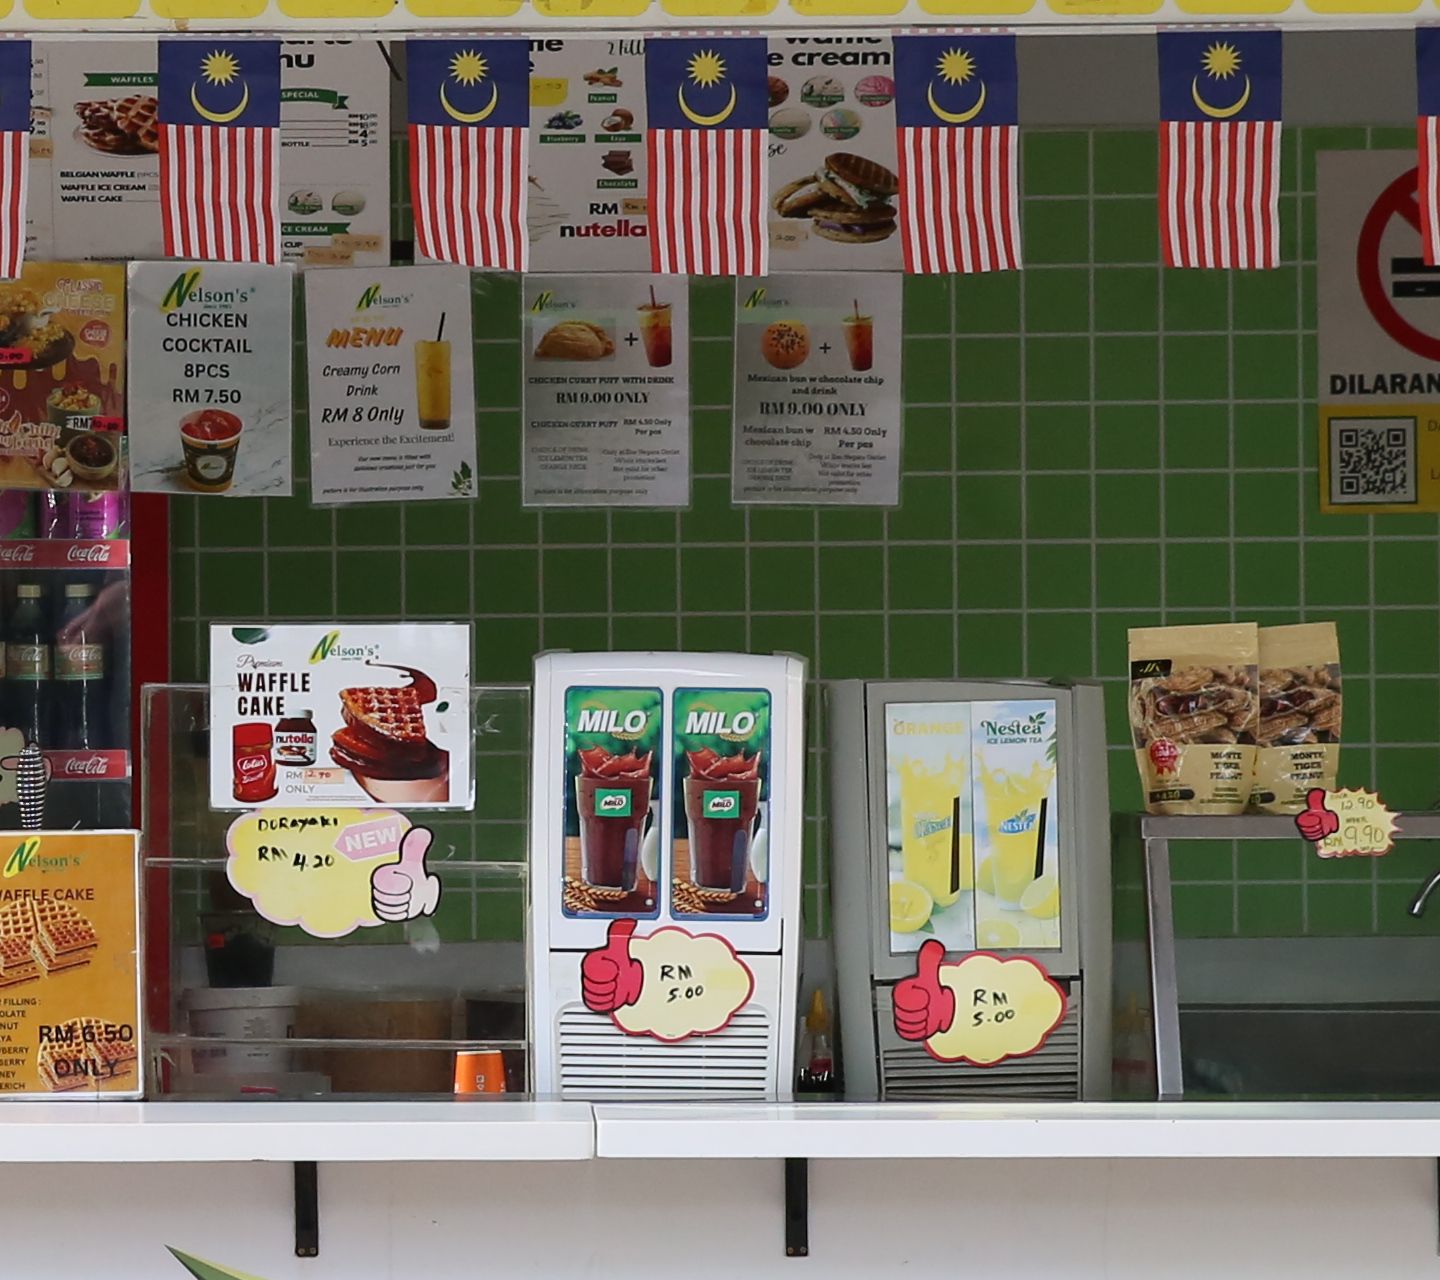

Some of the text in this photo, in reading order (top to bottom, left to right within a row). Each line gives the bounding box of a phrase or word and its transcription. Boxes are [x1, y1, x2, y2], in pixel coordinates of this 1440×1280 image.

[792, 51, 890, 66] cream
[590, 203, 618, 215] RM
[560, 220, 646, 238] nutella
[163, 272, 248, 308] Nelson's
[357, 286, 409, 308] Nelson's
[167, 313, 247, 328] CHICKEN
[163, 338, 252, 353] COCKTAIL
[326, 327, 403, 348] MENU
[184, 364, 229, 378] 8PCS
[323, 364, 400, 378] Creamy Corn
[748, 374, 787, 383] Mexican
[790, 375, 806, 383] bun
[819, 375, 861, 383] chocolate
[864, 376, 884, 385] chip
[173, 389, 241, 403] RM 7.50
[347, 385, 378, 396] Drink
[556, 392, 650, 403] RM 9.00 ONLY
[322, 406, 404, 425] RM 8 Only
[759, 402, 867, 416] RM 9.00 ONLY
[329, 433, 454, 448] Experience the Excitement!
[311, 634, 373, 660] Nelson's
[237, 673, 310, 692] WAFFLE
[238, 696, 284, 715] CAKE
[577, 710, 648, 733] MILO
[685, 711, 756, 734] MILO
[893, 721, 962, 736] ORANGE
[981, 720, 1041, 736] Nestea
[276, 733, 313, 743] nutella
[1211, 752, 1242, 760] MONTE
[1214, 762, 1240, 770] TIGER
[286, 771, 302, 779] RM
[286, 785, 315, 793] ONLY
[345, 827, 396, 852] NEW
[1344, 825, 1384, 844] 9.90
[6, 841, 80, 872] Nelson's
[258, 846, 334, 871] RM 4.20
[54, 888, 94, 900] CAKE
[660, 964, 692, 984] RM
[666, 984, 704, 1003] 5.00
[972, 990, 1008, 1006] RM
[4, 998, 36, 1006] FILLING
[972, 1008, 1015, 1028] 5.00
[39, 1024, 133, 1043] RM 6.50
[54, 1058, 121, 1077] ONLY
